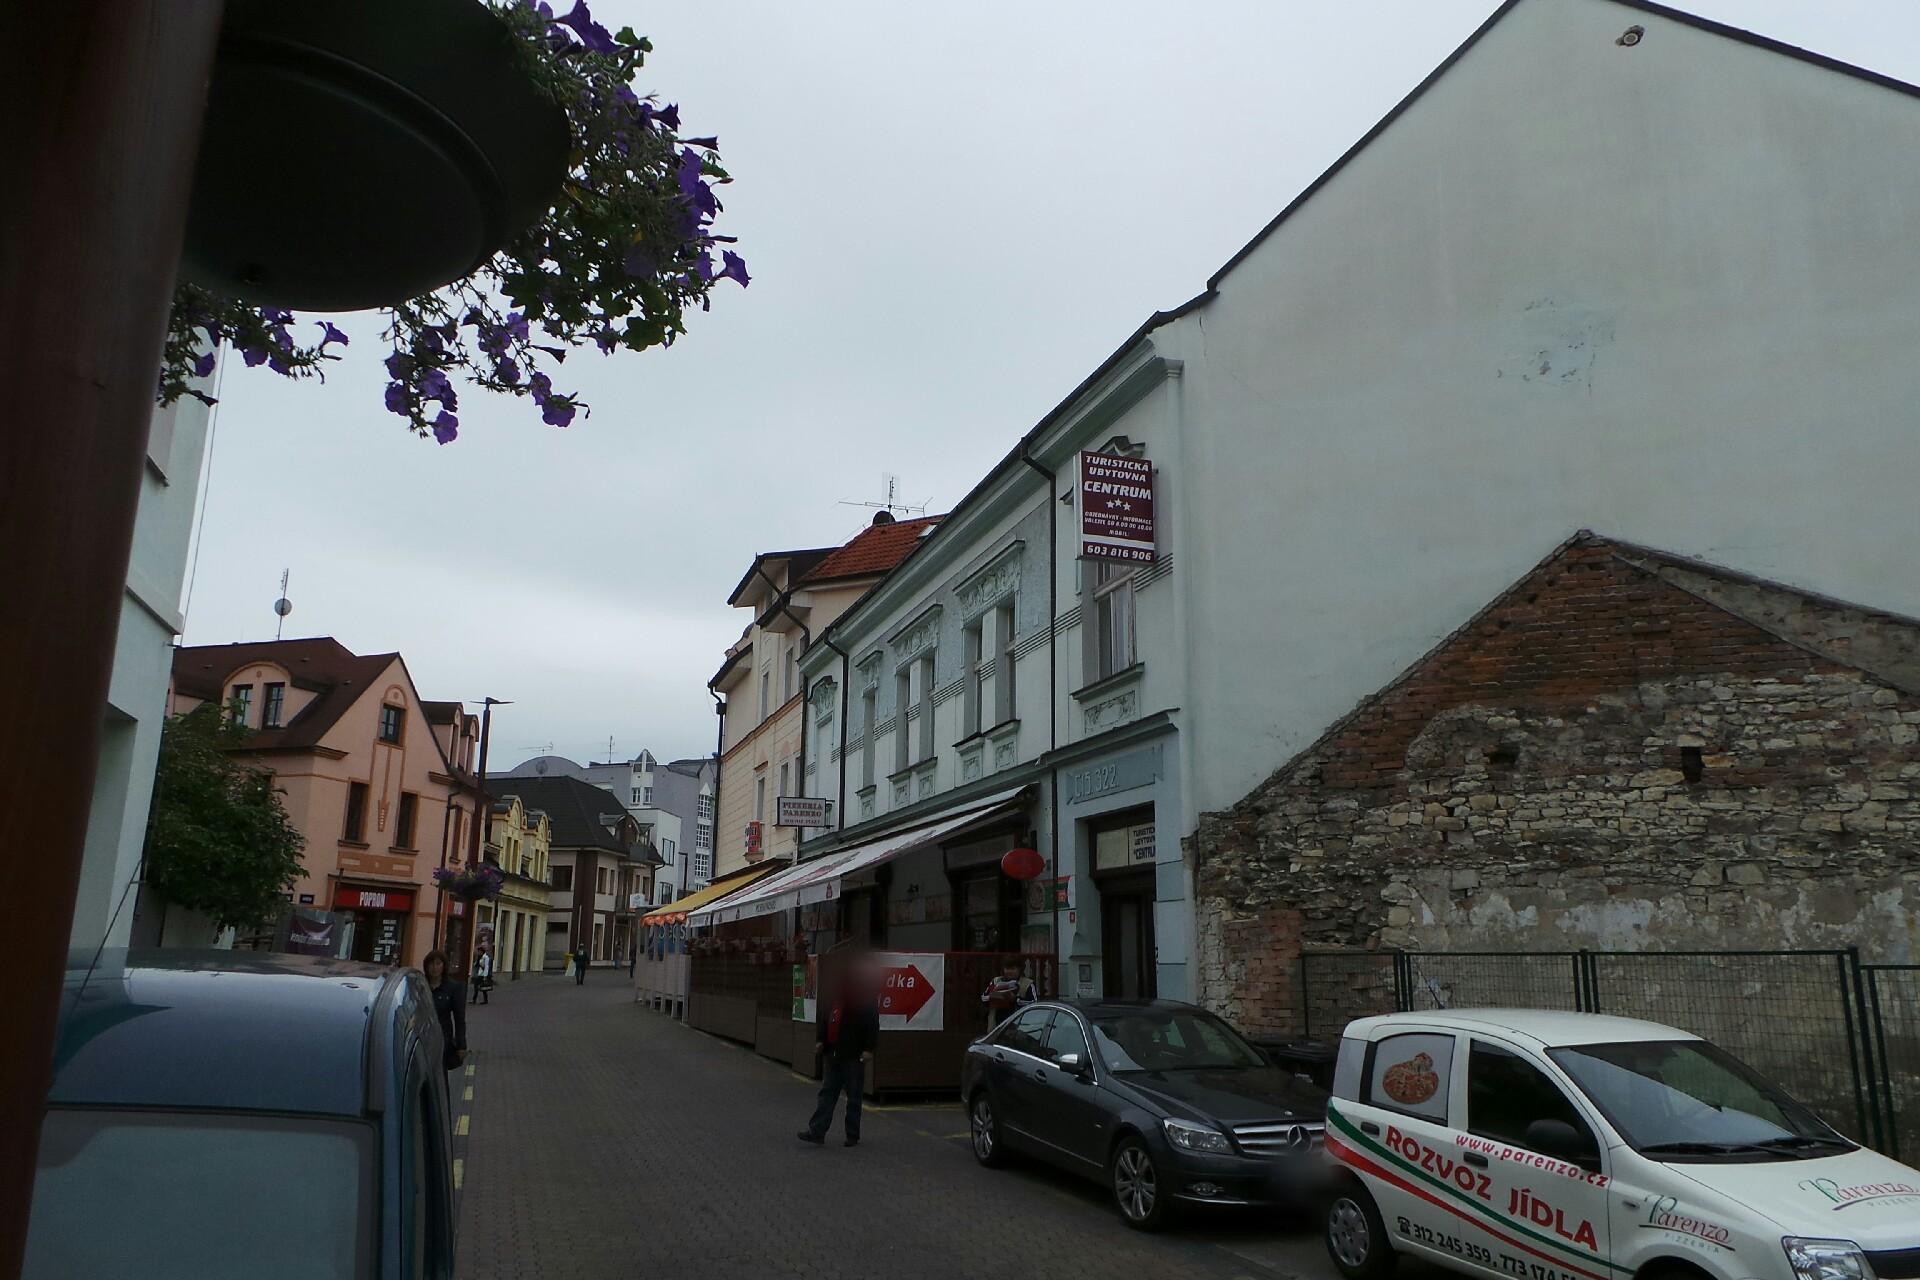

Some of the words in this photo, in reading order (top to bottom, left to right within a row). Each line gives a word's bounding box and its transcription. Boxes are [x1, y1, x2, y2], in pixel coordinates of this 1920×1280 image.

[1086, 456, 1149, 471] TURISTICKÁ
[1089, 467, 1146, 482] UBYTOVNA
[1084, 481, 1151, 500] CENTRUM
[1087, 545, 1107, 555] 603
[1110, 547, 1129, 558] 816
[1132, 550, 1151, 560] 906
[360, 891, 385, 908] POPRON
[1456, 1135, 1609, 1187] www.parenzo.cz
[1386, 1125, 1491, 1201] ROZVOZ
[1508, 1187, 1598, 1252] JÍDLA
[1798, 1178, 1919, 1203] Parenzo
[1644, 1194, 1733, 1243] Parenzo
[1413, 1224, 1435, 1243] 312
[1437, 1232, 1463, 1253] 245
[1501, 1254, 1528, 1276] 773
[1664, 1233, 1720, 1255] PIZZERIA
